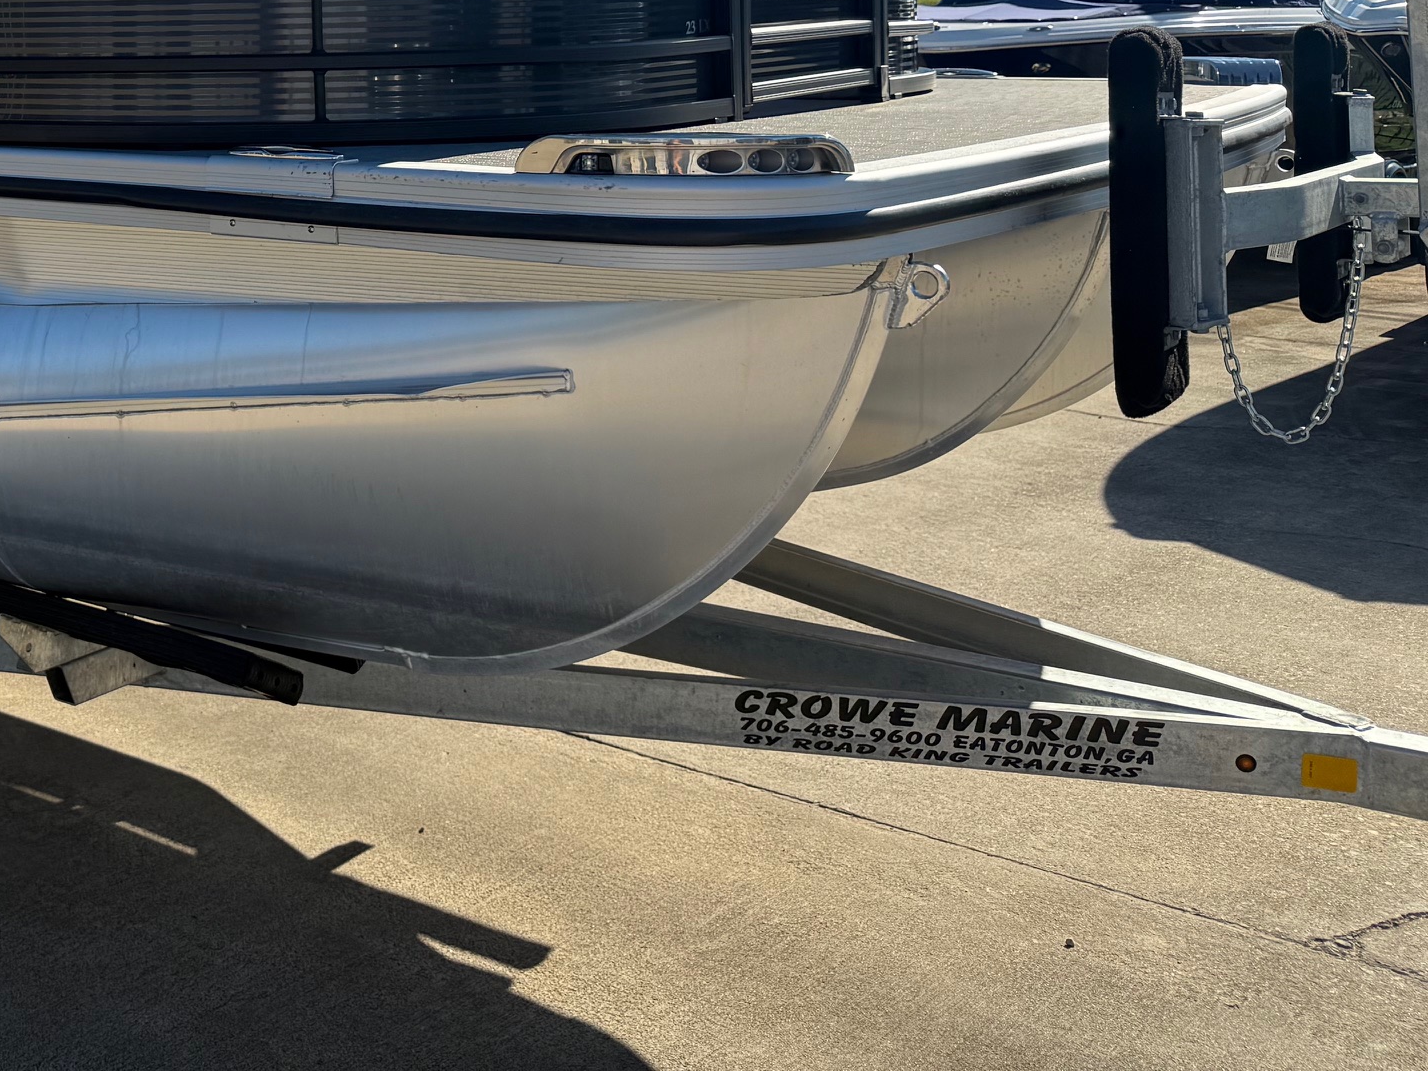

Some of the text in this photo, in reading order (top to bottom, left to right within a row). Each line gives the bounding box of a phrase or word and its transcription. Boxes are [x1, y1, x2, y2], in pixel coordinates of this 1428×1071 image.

[685, 20, 696, 35] 23
[734, 690, 1166, 747] CROWE MARINE
[740, 717, 1155, 765] 706-485-9600 EATONTON,GA
[743, 734, 1143, 778] BY ROAD KING TRAILERS
